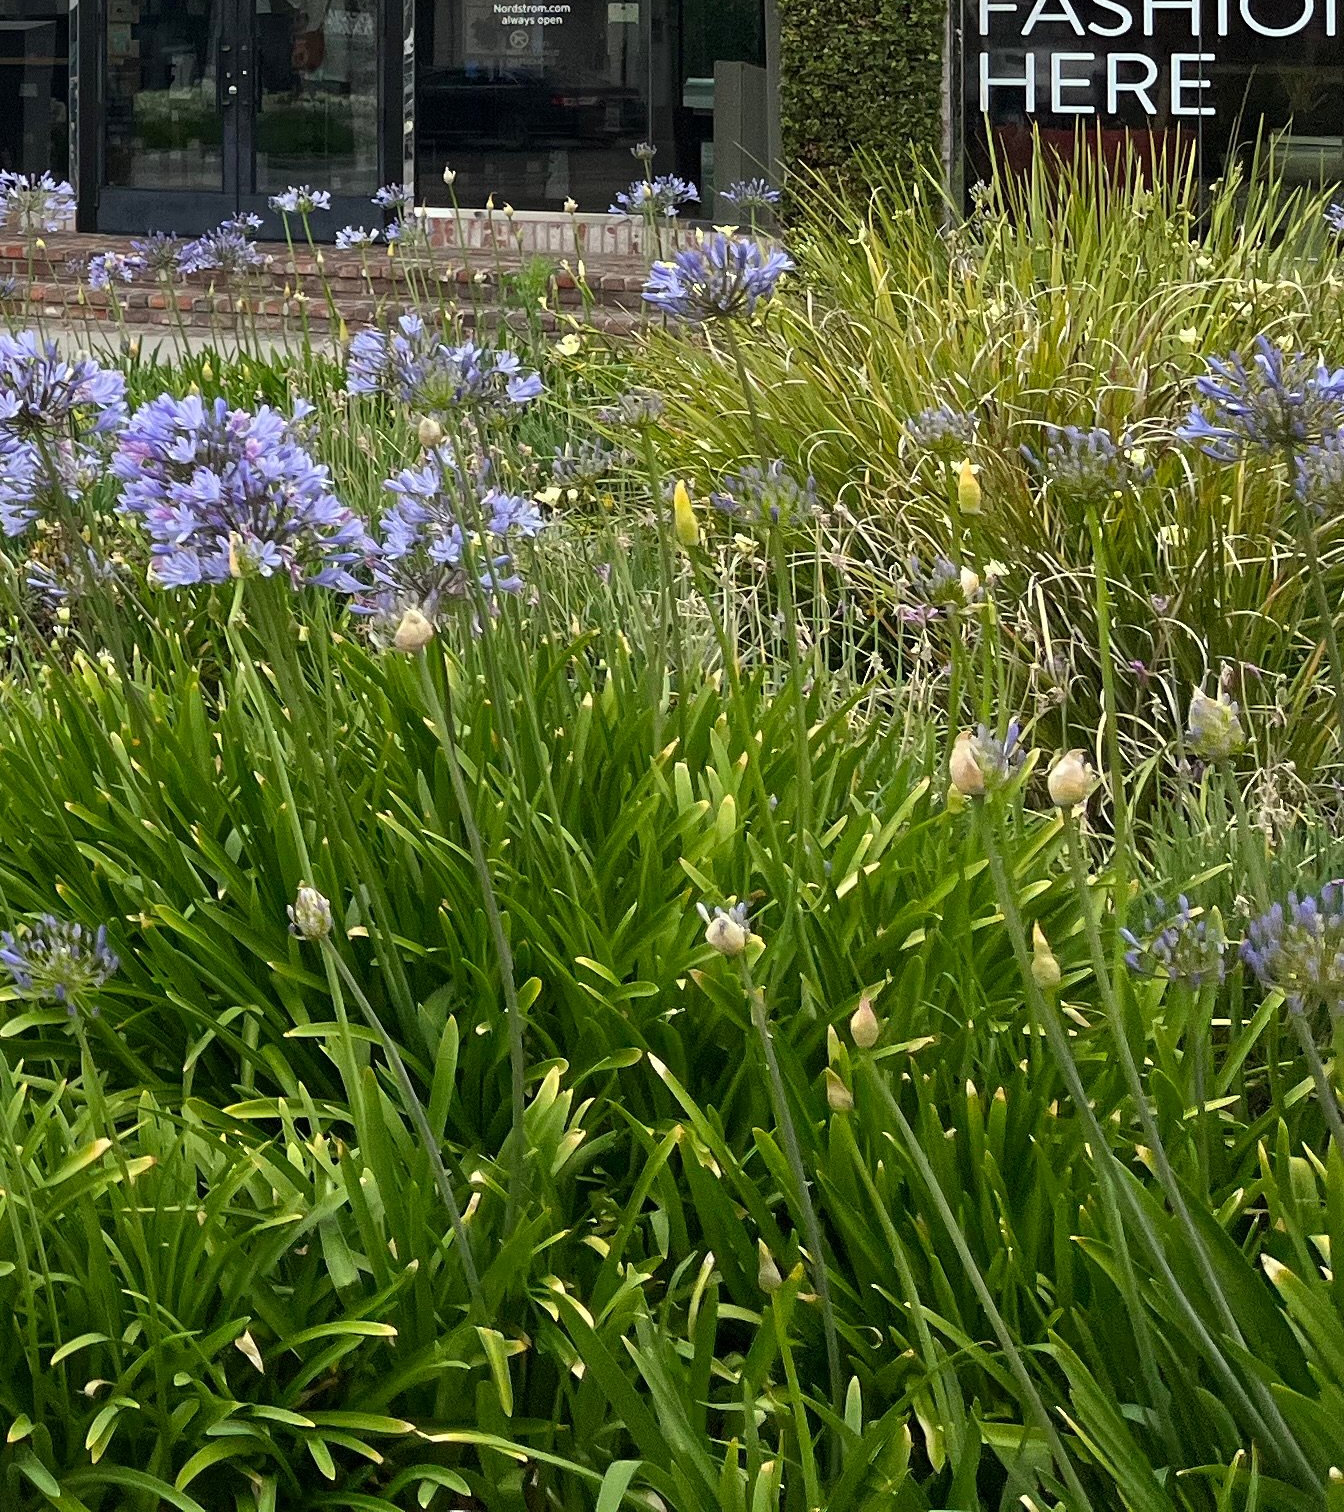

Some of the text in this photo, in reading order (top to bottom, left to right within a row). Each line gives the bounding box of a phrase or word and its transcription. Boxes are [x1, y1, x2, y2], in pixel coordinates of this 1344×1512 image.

[493, 4, 571, 14] Nordstrom.com
[501, 15, 563, 27] always open
[979, 52, 1216, 115] HERE
